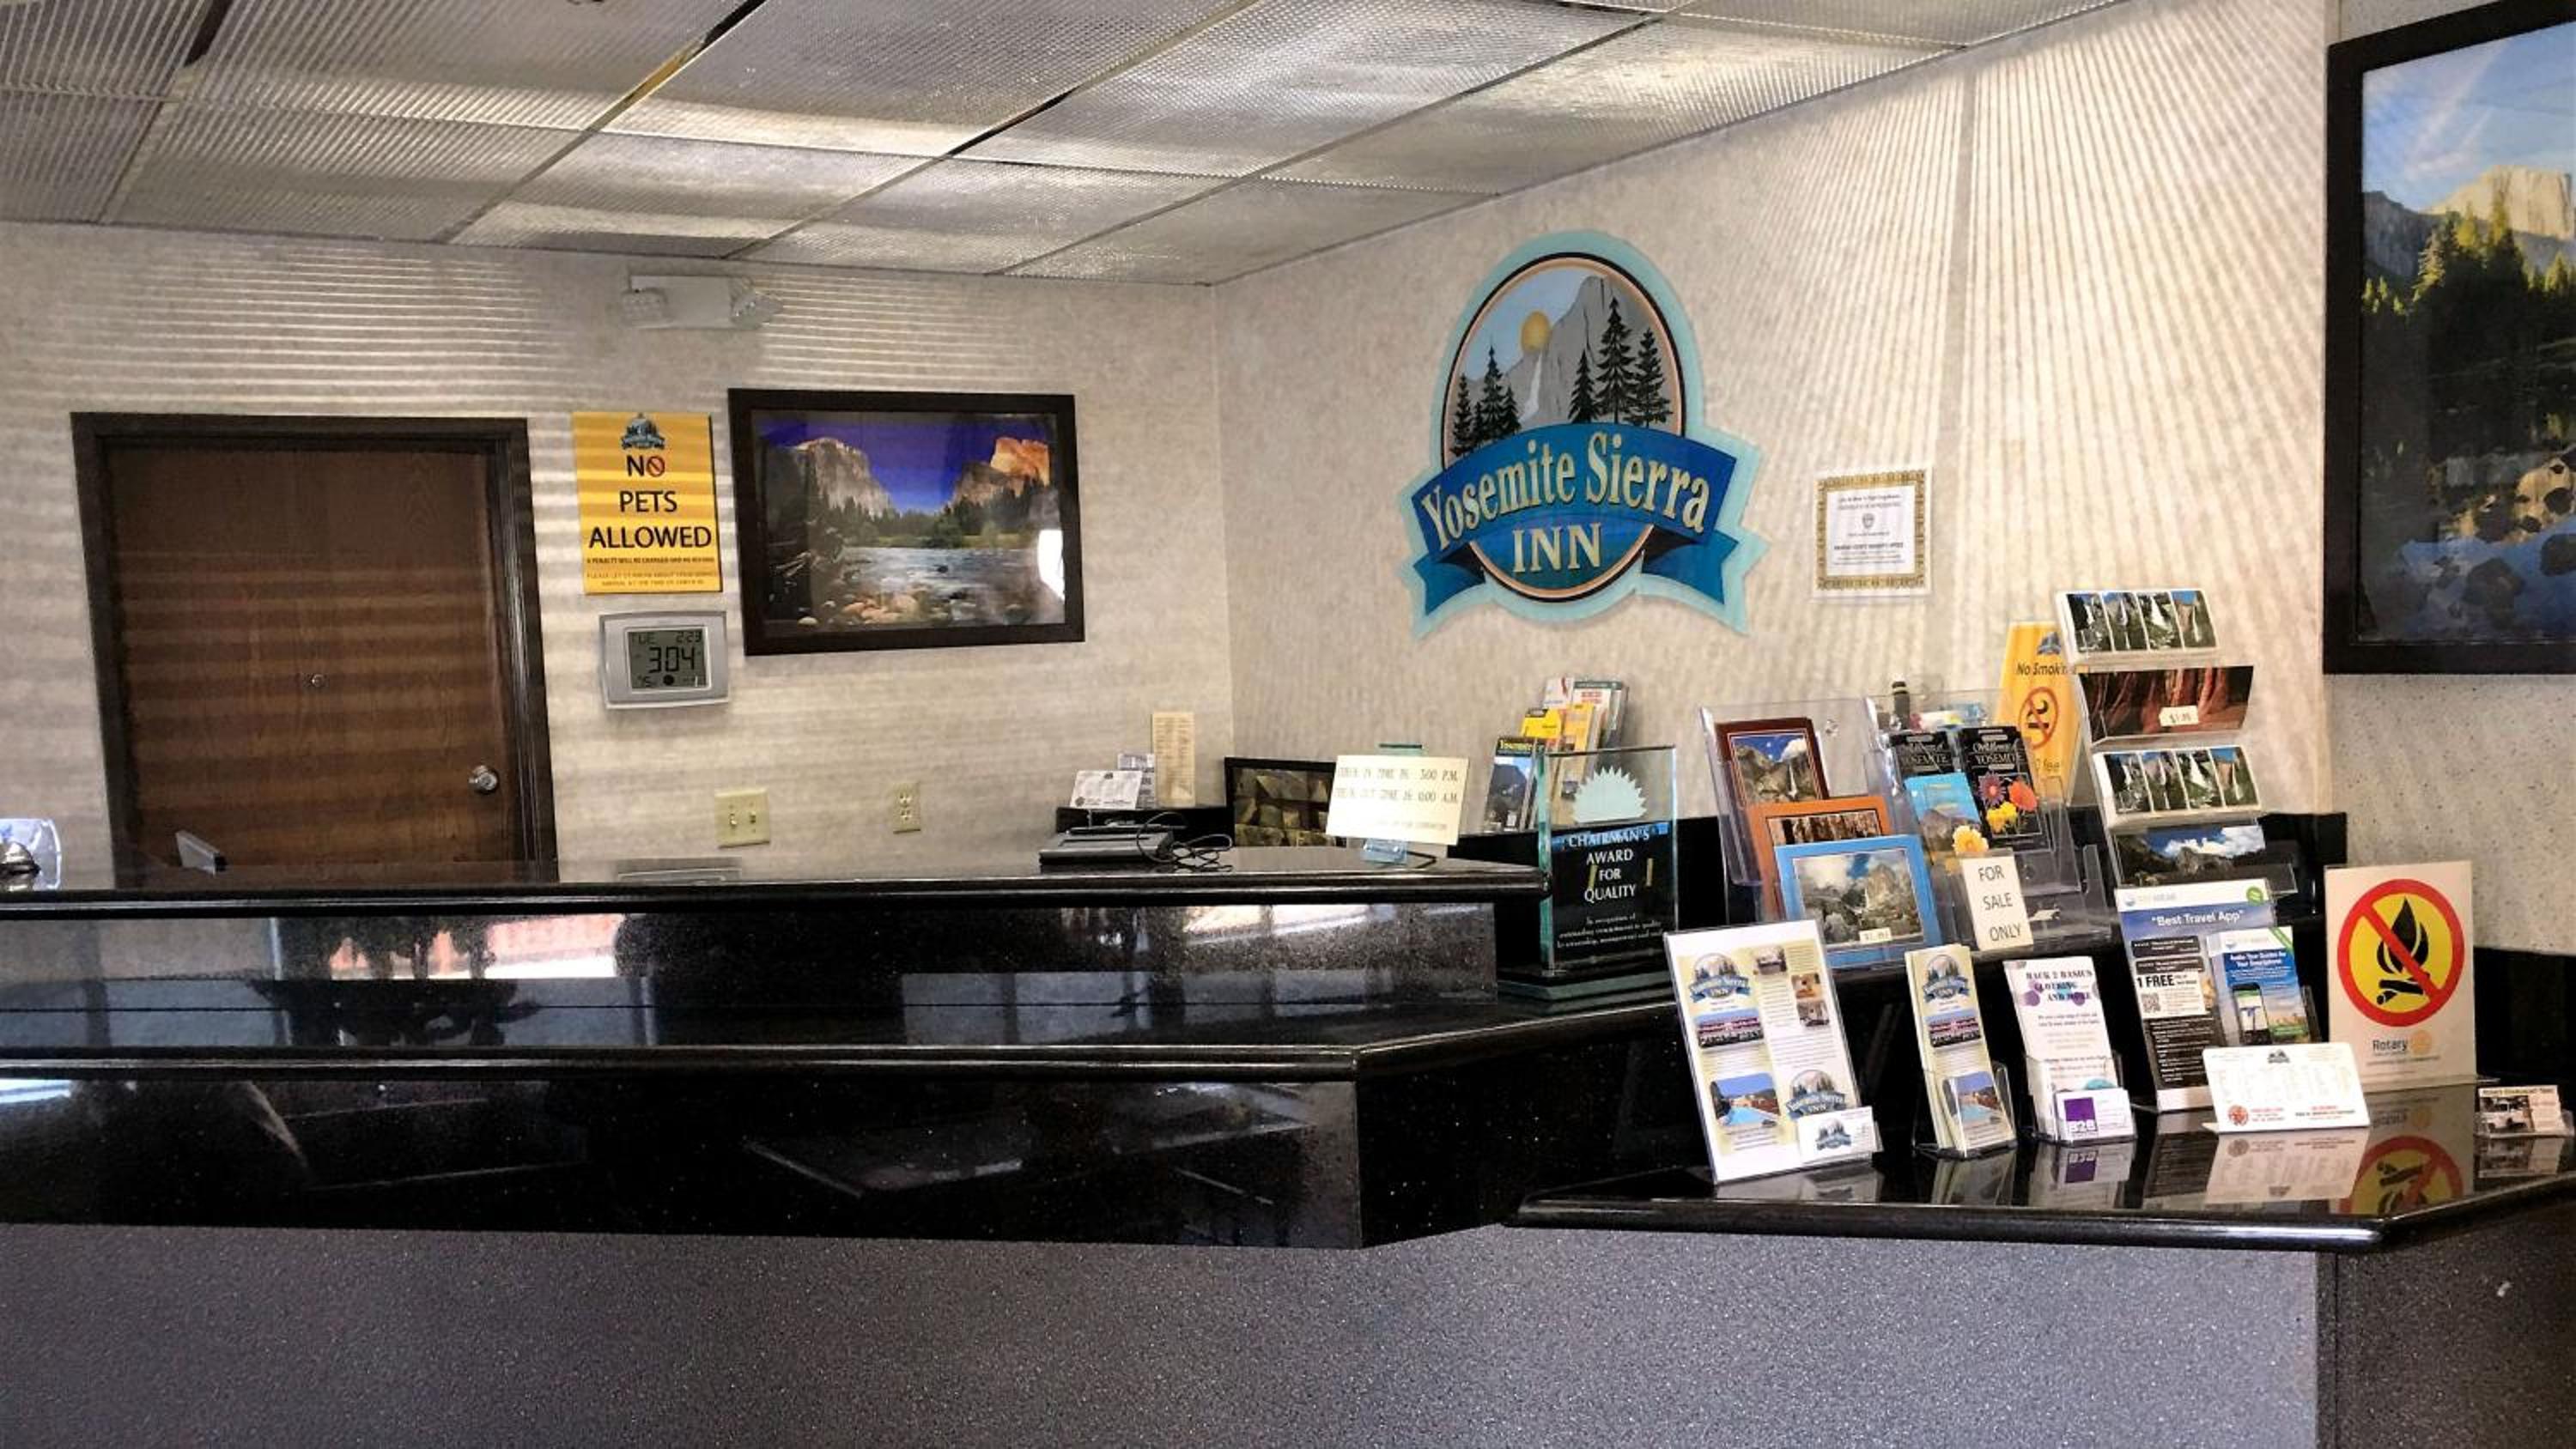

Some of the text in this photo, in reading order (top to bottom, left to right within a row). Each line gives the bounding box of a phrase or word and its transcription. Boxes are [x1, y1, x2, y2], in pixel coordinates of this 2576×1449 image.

[626, 455, 665, 477] NO
[619, 490, 677, 512] PETS
[1421, 433, 1710, 551] Yosemite Sierra
[589, 526, 712, 549] ALLOWED
[1512, 522, 1603, 573] INN
[2016, 662, 2075, 676] No Smok
[1569, 826, 1649, 848] CHAIRMAN'S
[1586, 848, 1634, 866] AWARD
[1598, 868, 1622, 882] FOR
[1978, 864, 2005, 882] FOR
[1583, 883, 1637, 904] QUALITY
[1983, 892, 2013, 910] SALE
[2184, 912, 2216, 925] Travel
[1990, 923, 2021, 942] ONLY
[2136, 977, 2142, 988] 1
[2146, 974, 2174, 987] FREE
[2372, 1040, 2408, 1052] Rotary
